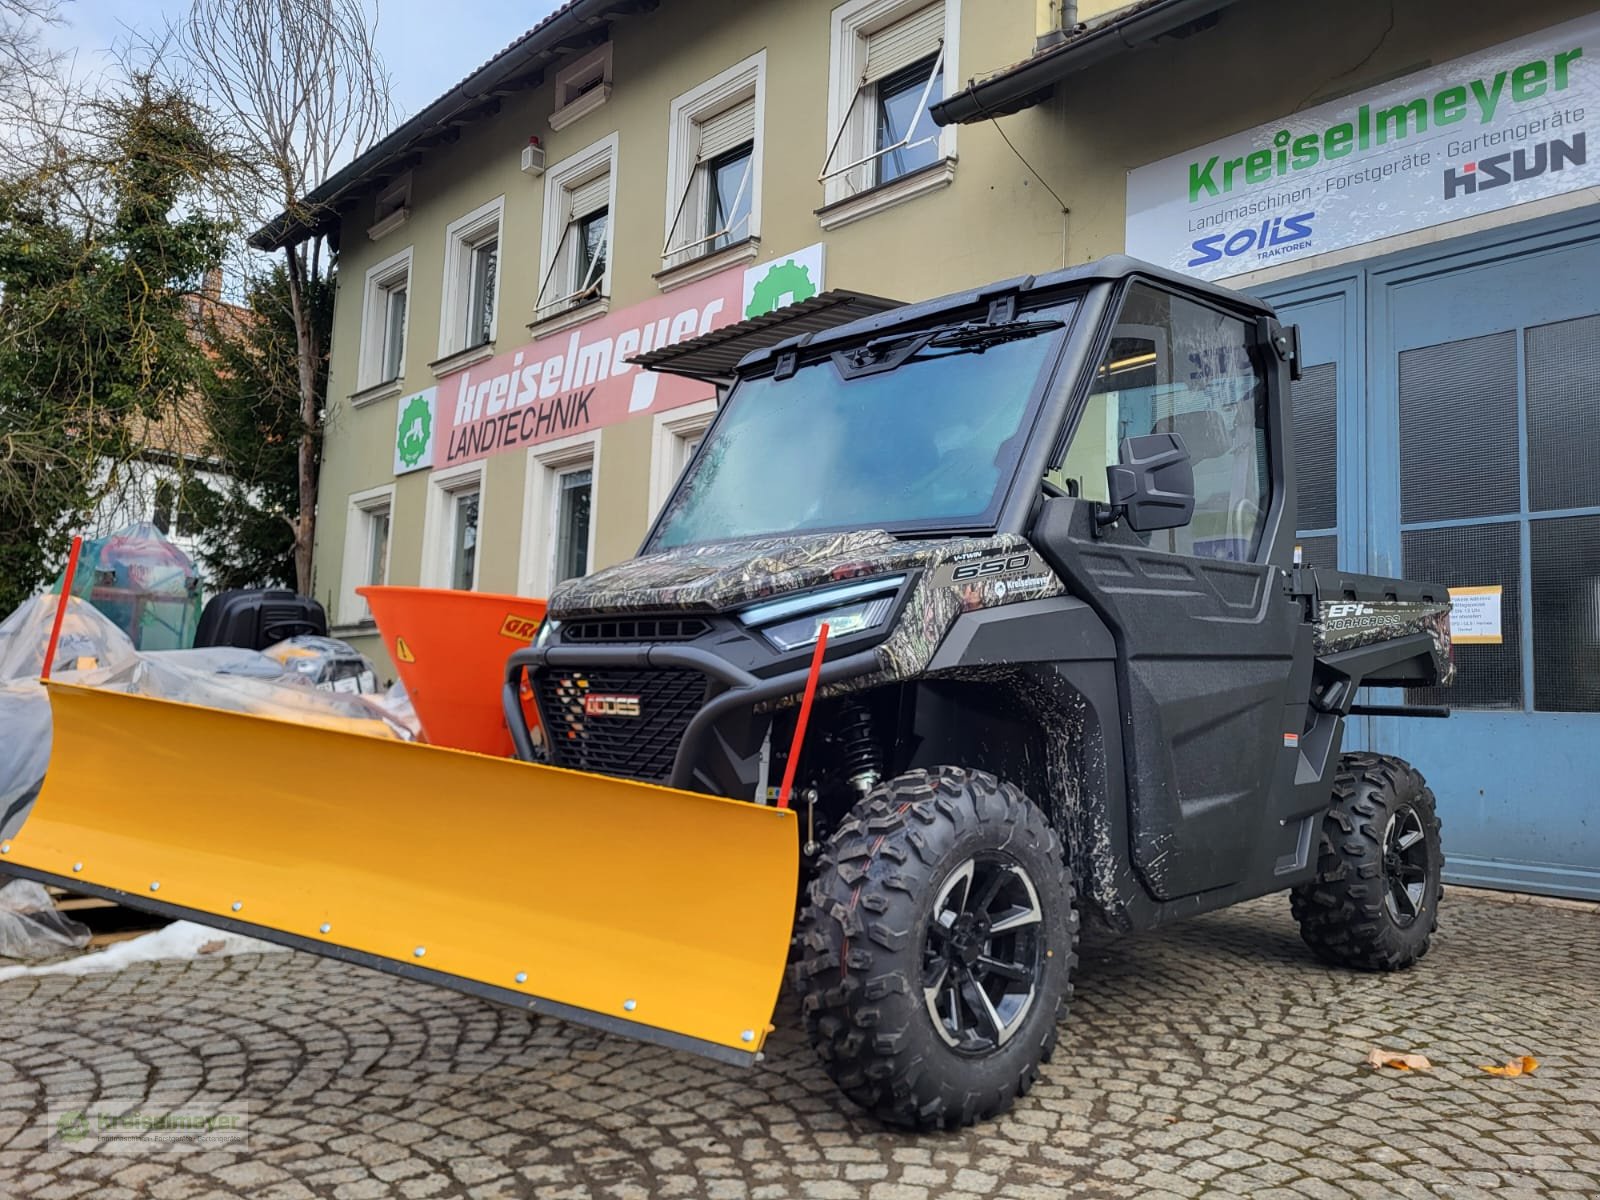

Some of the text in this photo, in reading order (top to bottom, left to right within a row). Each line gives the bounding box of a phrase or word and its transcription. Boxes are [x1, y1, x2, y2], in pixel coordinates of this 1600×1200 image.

[1188, 47, 1583, 203] Kreiselmeyer
[1188, 107, 1586, 232] Landmaschinen Forstgeräte Gartengeräte
[1257, 240, 1312, 260] TRAKTOREN
[447, 387, 595, 461] LANDTECHNIK
[951, 554, 1031, 582] 650
[953, 551, 982, 562] V-TWIN
